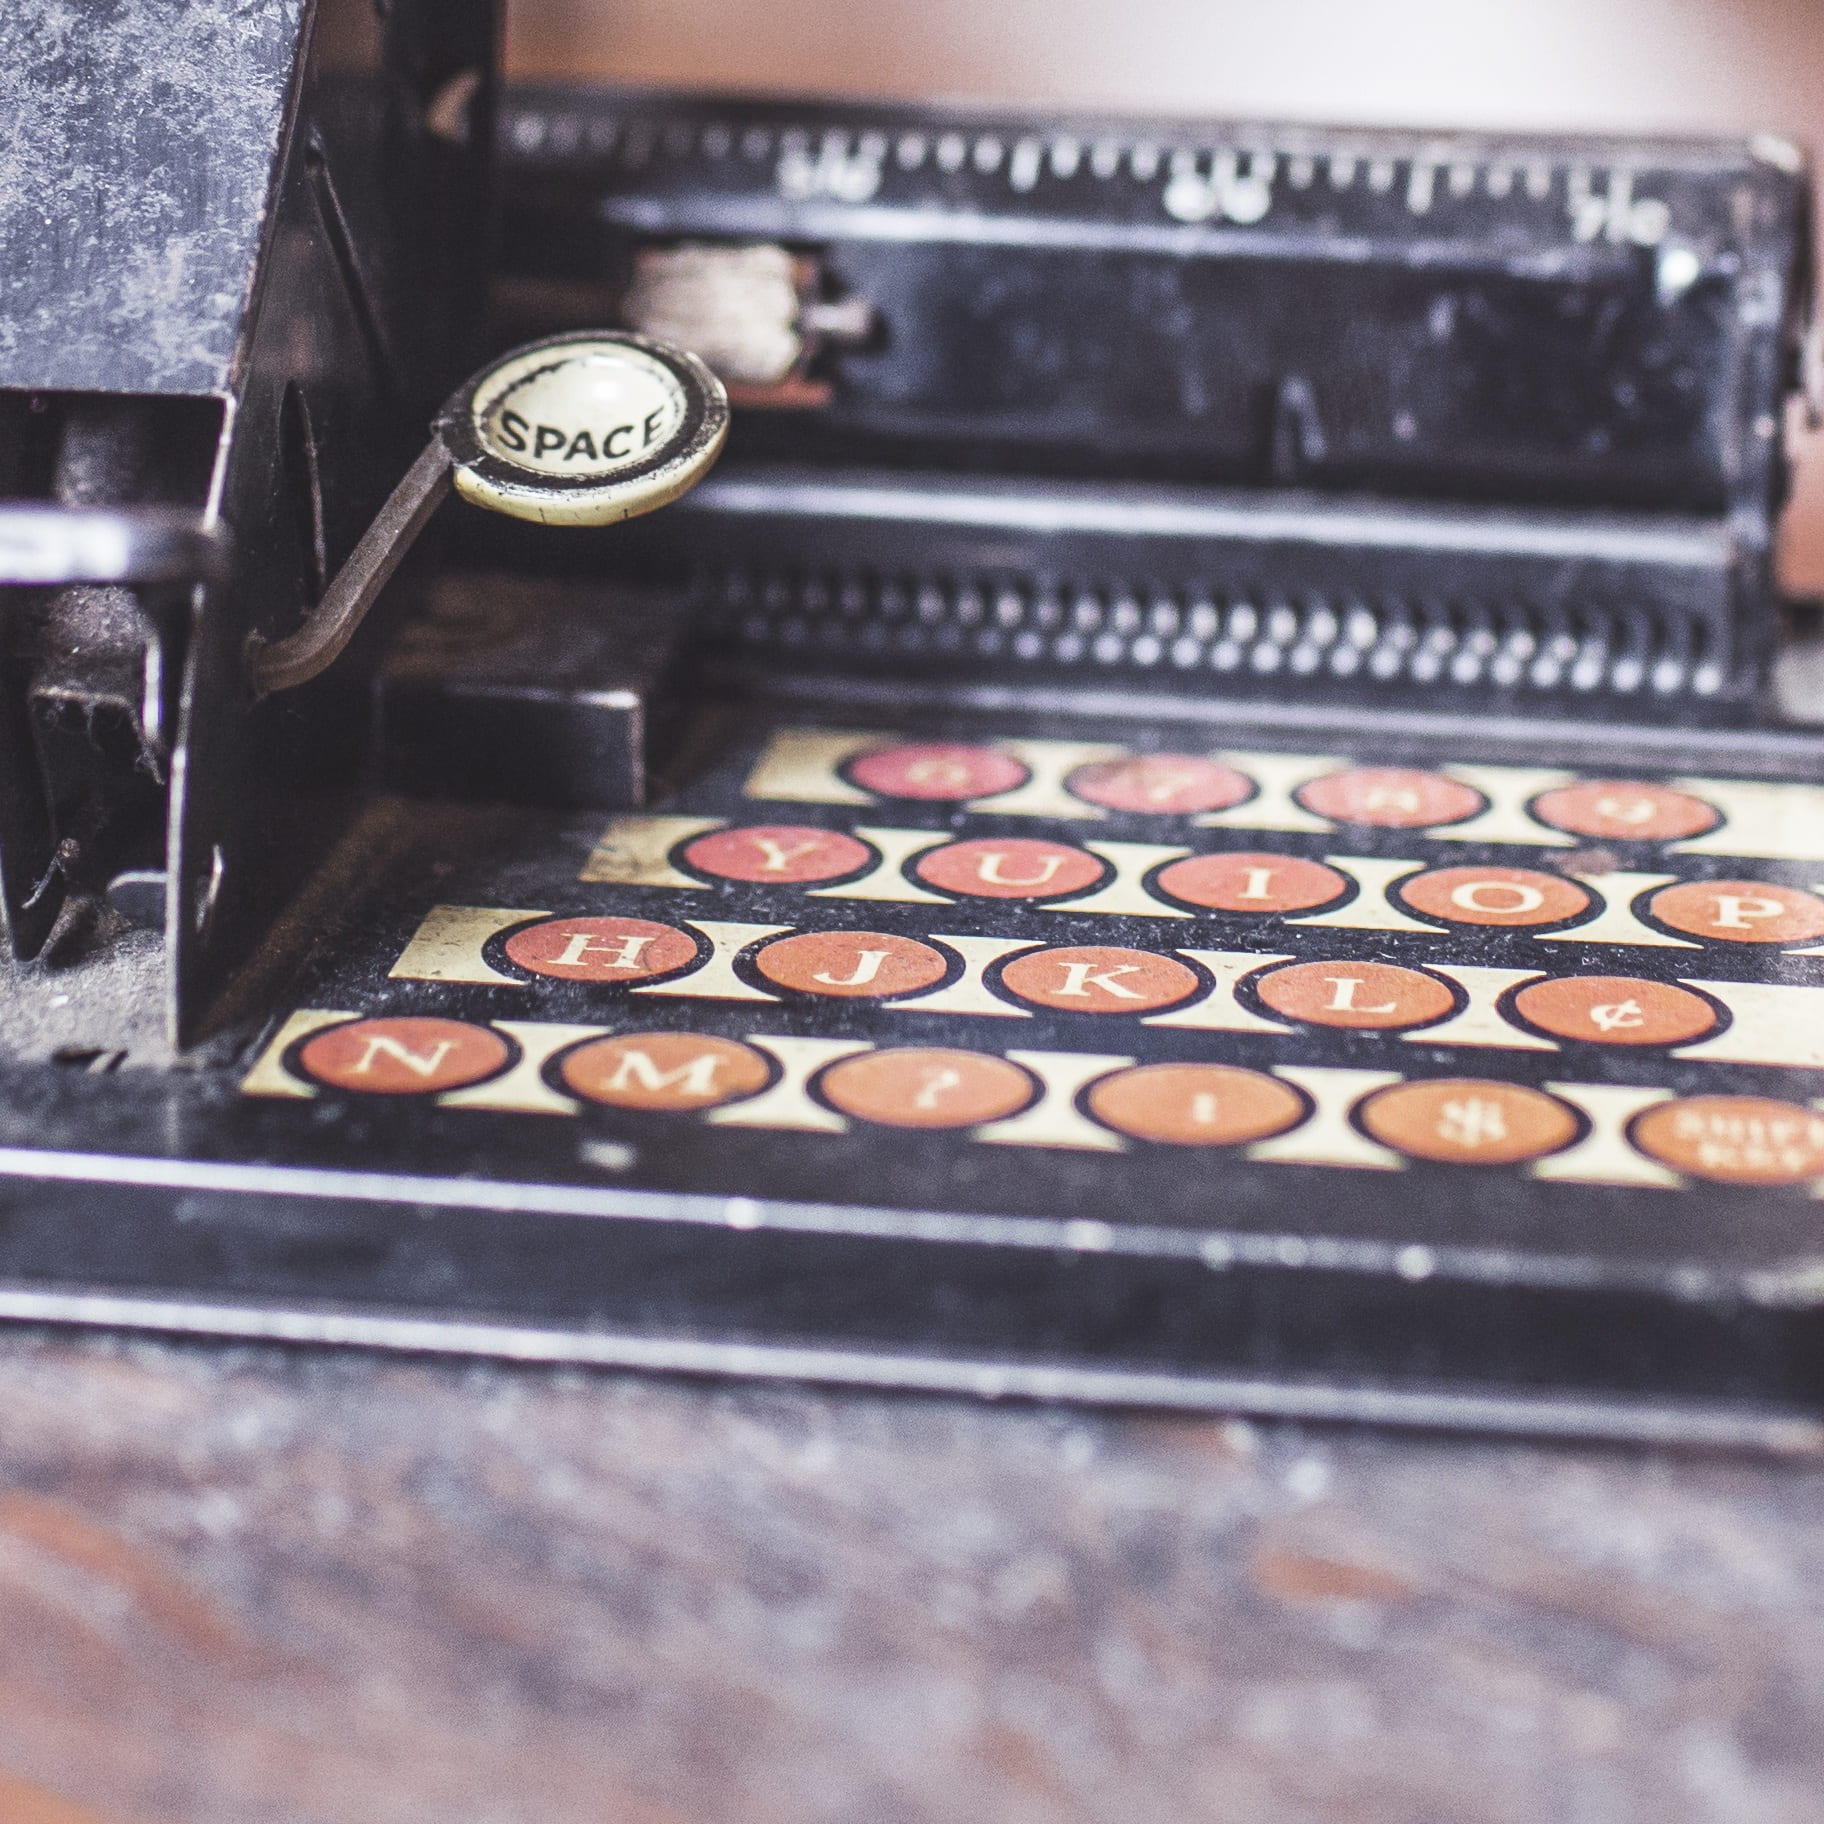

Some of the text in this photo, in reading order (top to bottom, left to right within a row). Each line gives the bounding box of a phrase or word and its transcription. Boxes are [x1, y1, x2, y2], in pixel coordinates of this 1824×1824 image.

[497, 404, 666, 462] SPACE
[749, 836, 1786, 931] Y U I O P
[545, 931, 657, 970] H
[812, 949, 893, 988] J
[1049, 960, 1151, 1001] K
[1322, 976, 1399, 1015] L
[339, 1034, 463, 1077] N
[600, 1050, 736, 1096] M
